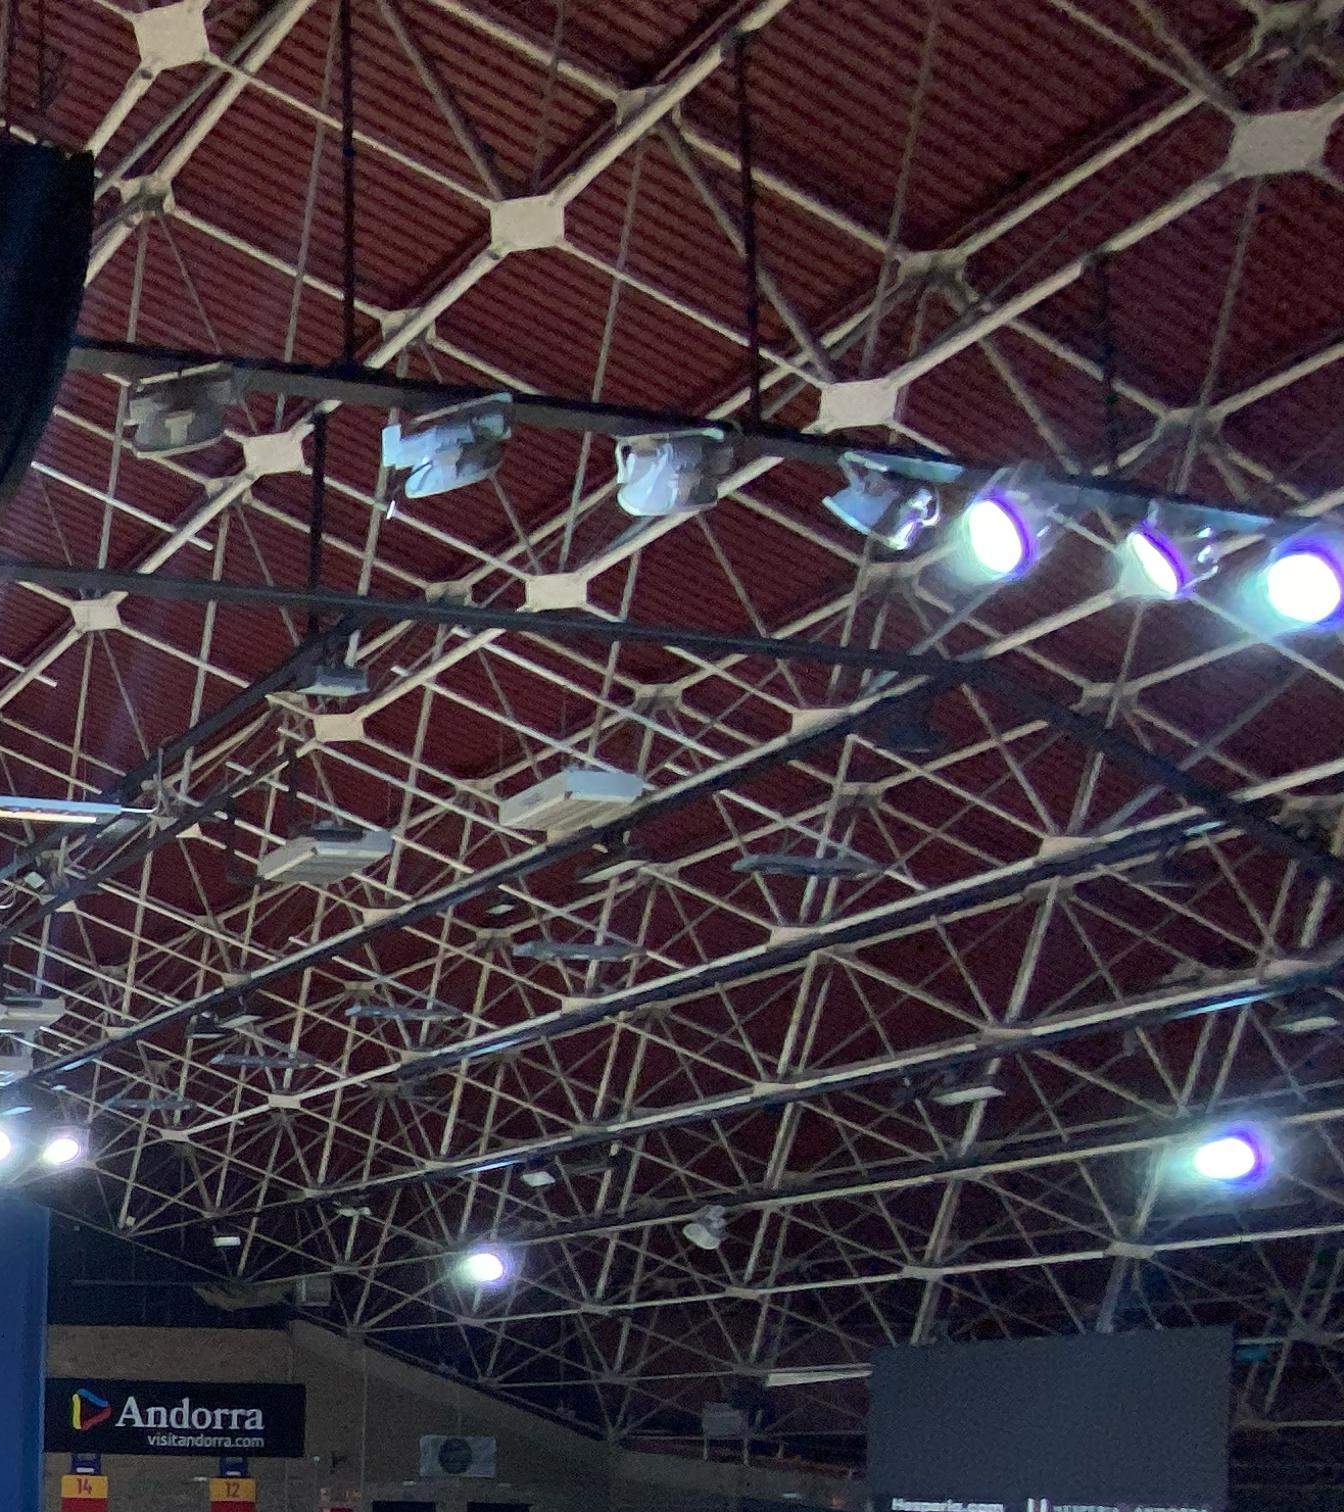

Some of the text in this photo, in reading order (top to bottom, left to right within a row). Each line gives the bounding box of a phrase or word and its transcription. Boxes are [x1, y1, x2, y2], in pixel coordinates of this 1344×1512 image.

[115, 1396, 265, 1430] Andorra
[147, 1433, 265, 1448] visitandorra.com
[75, 1478, 93, 1496] 14
[225, 1482, 240, 1498] 12
